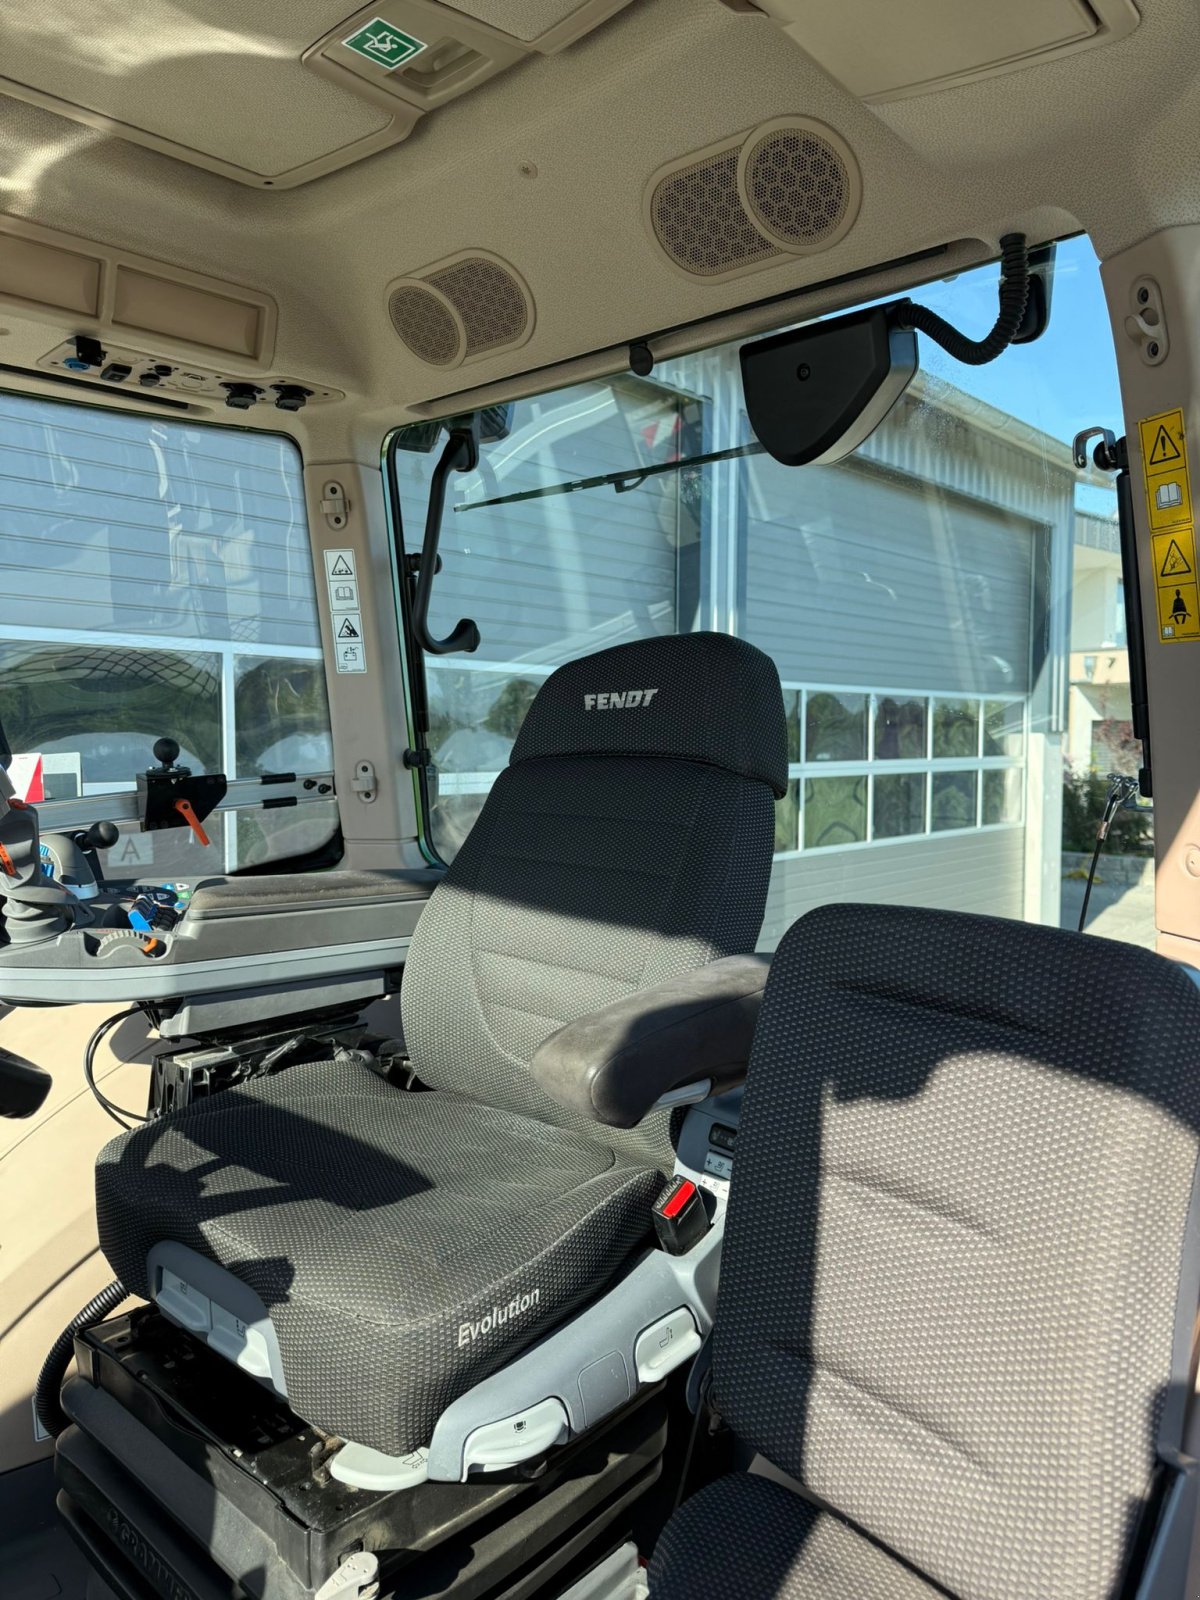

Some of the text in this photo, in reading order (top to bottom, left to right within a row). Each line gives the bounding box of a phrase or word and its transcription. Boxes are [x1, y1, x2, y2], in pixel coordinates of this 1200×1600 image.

[584, 688, 659, 711] FENDT
[121, 835, 141, 862] A
[458, 1288, 540, 1347] Evolution
